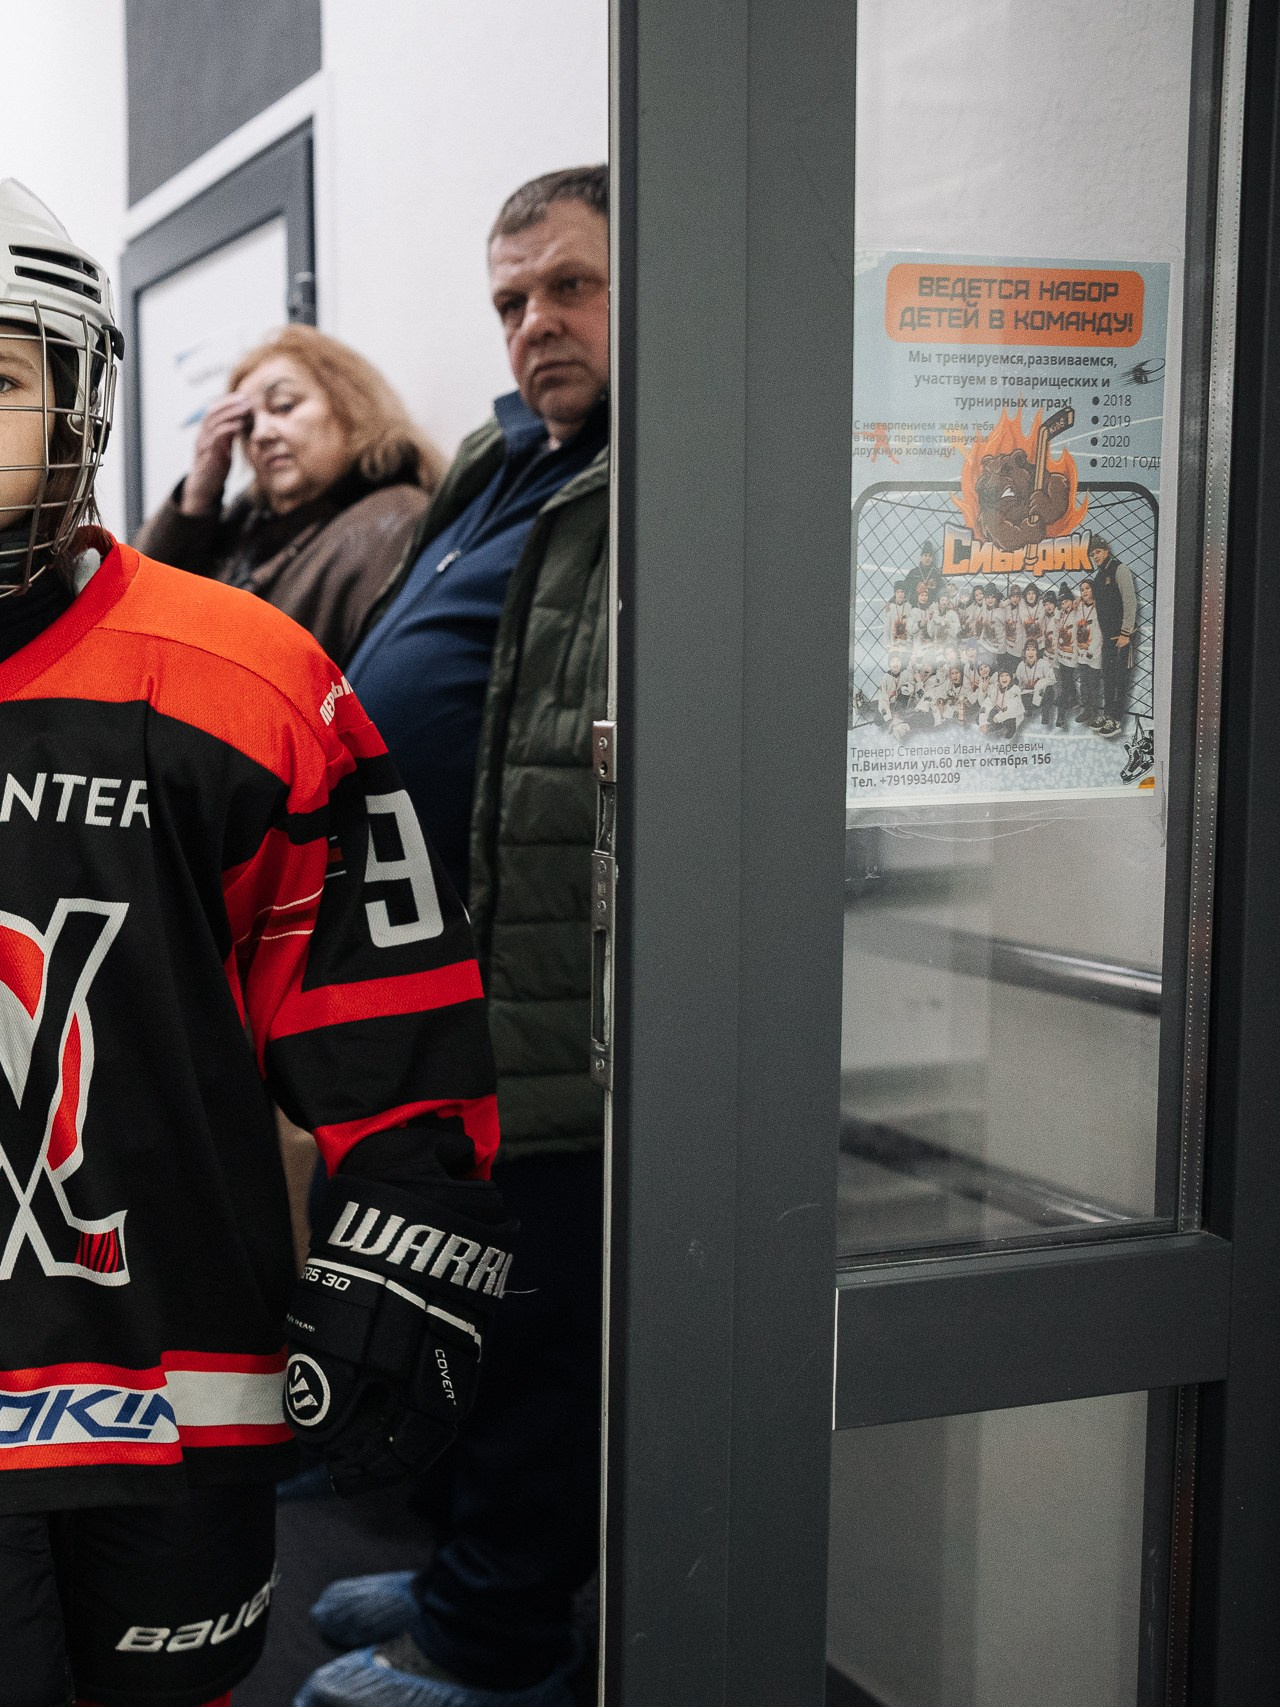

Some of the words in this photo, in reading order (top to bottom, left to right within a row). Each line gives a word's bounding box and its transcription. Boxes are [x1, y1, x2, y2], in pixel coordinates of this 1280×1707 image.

[918, 277, 1029, 302] ВЕДЕТСЯ
[1040, 281, 1118, 302] НАБОР
[898, 300, 979, 331] ДЕТЕЙ
[989, 309, 1004, 329] В
[1014, 311, 1133, 335] КОМАНДУ!
[909, 351, 932, 363] Мы
[914, 375, 986, 388] участвуем
[990, 376, 997, 386] в
[1001, 376, 1097, 389] товарищеских
[1101, 378, 1110, 387] и
[954, 396, 1027, 408] турнирных
[1031, 397, 1072, 408] играх!
[1104, 395, 1131, 407] 2018
[1103, 415, 1130, 427] 2019
[1102, 435, 1130, 447] 2020
[1101, 456, 1130, 468] 2021
[851, 746, 894, 759] Тренер:
[897, 744, 950, 756] Степанов
[953, 743, 981, 754] Иван
[984, 741, 1044, 753] Андреевич
[852, 761, 917, 772] п.Винзили
[922, 758, 952, 771] ул.60
[956, 758, 976, 768] лет
[980, 756, 1028, 768] октября
[852, 776, 876, 788] Тел.
[879, 773, 960, 786] +79199340209
[364, 790, 444, 948] 9
[322, 1273, 351, 1292] 30
